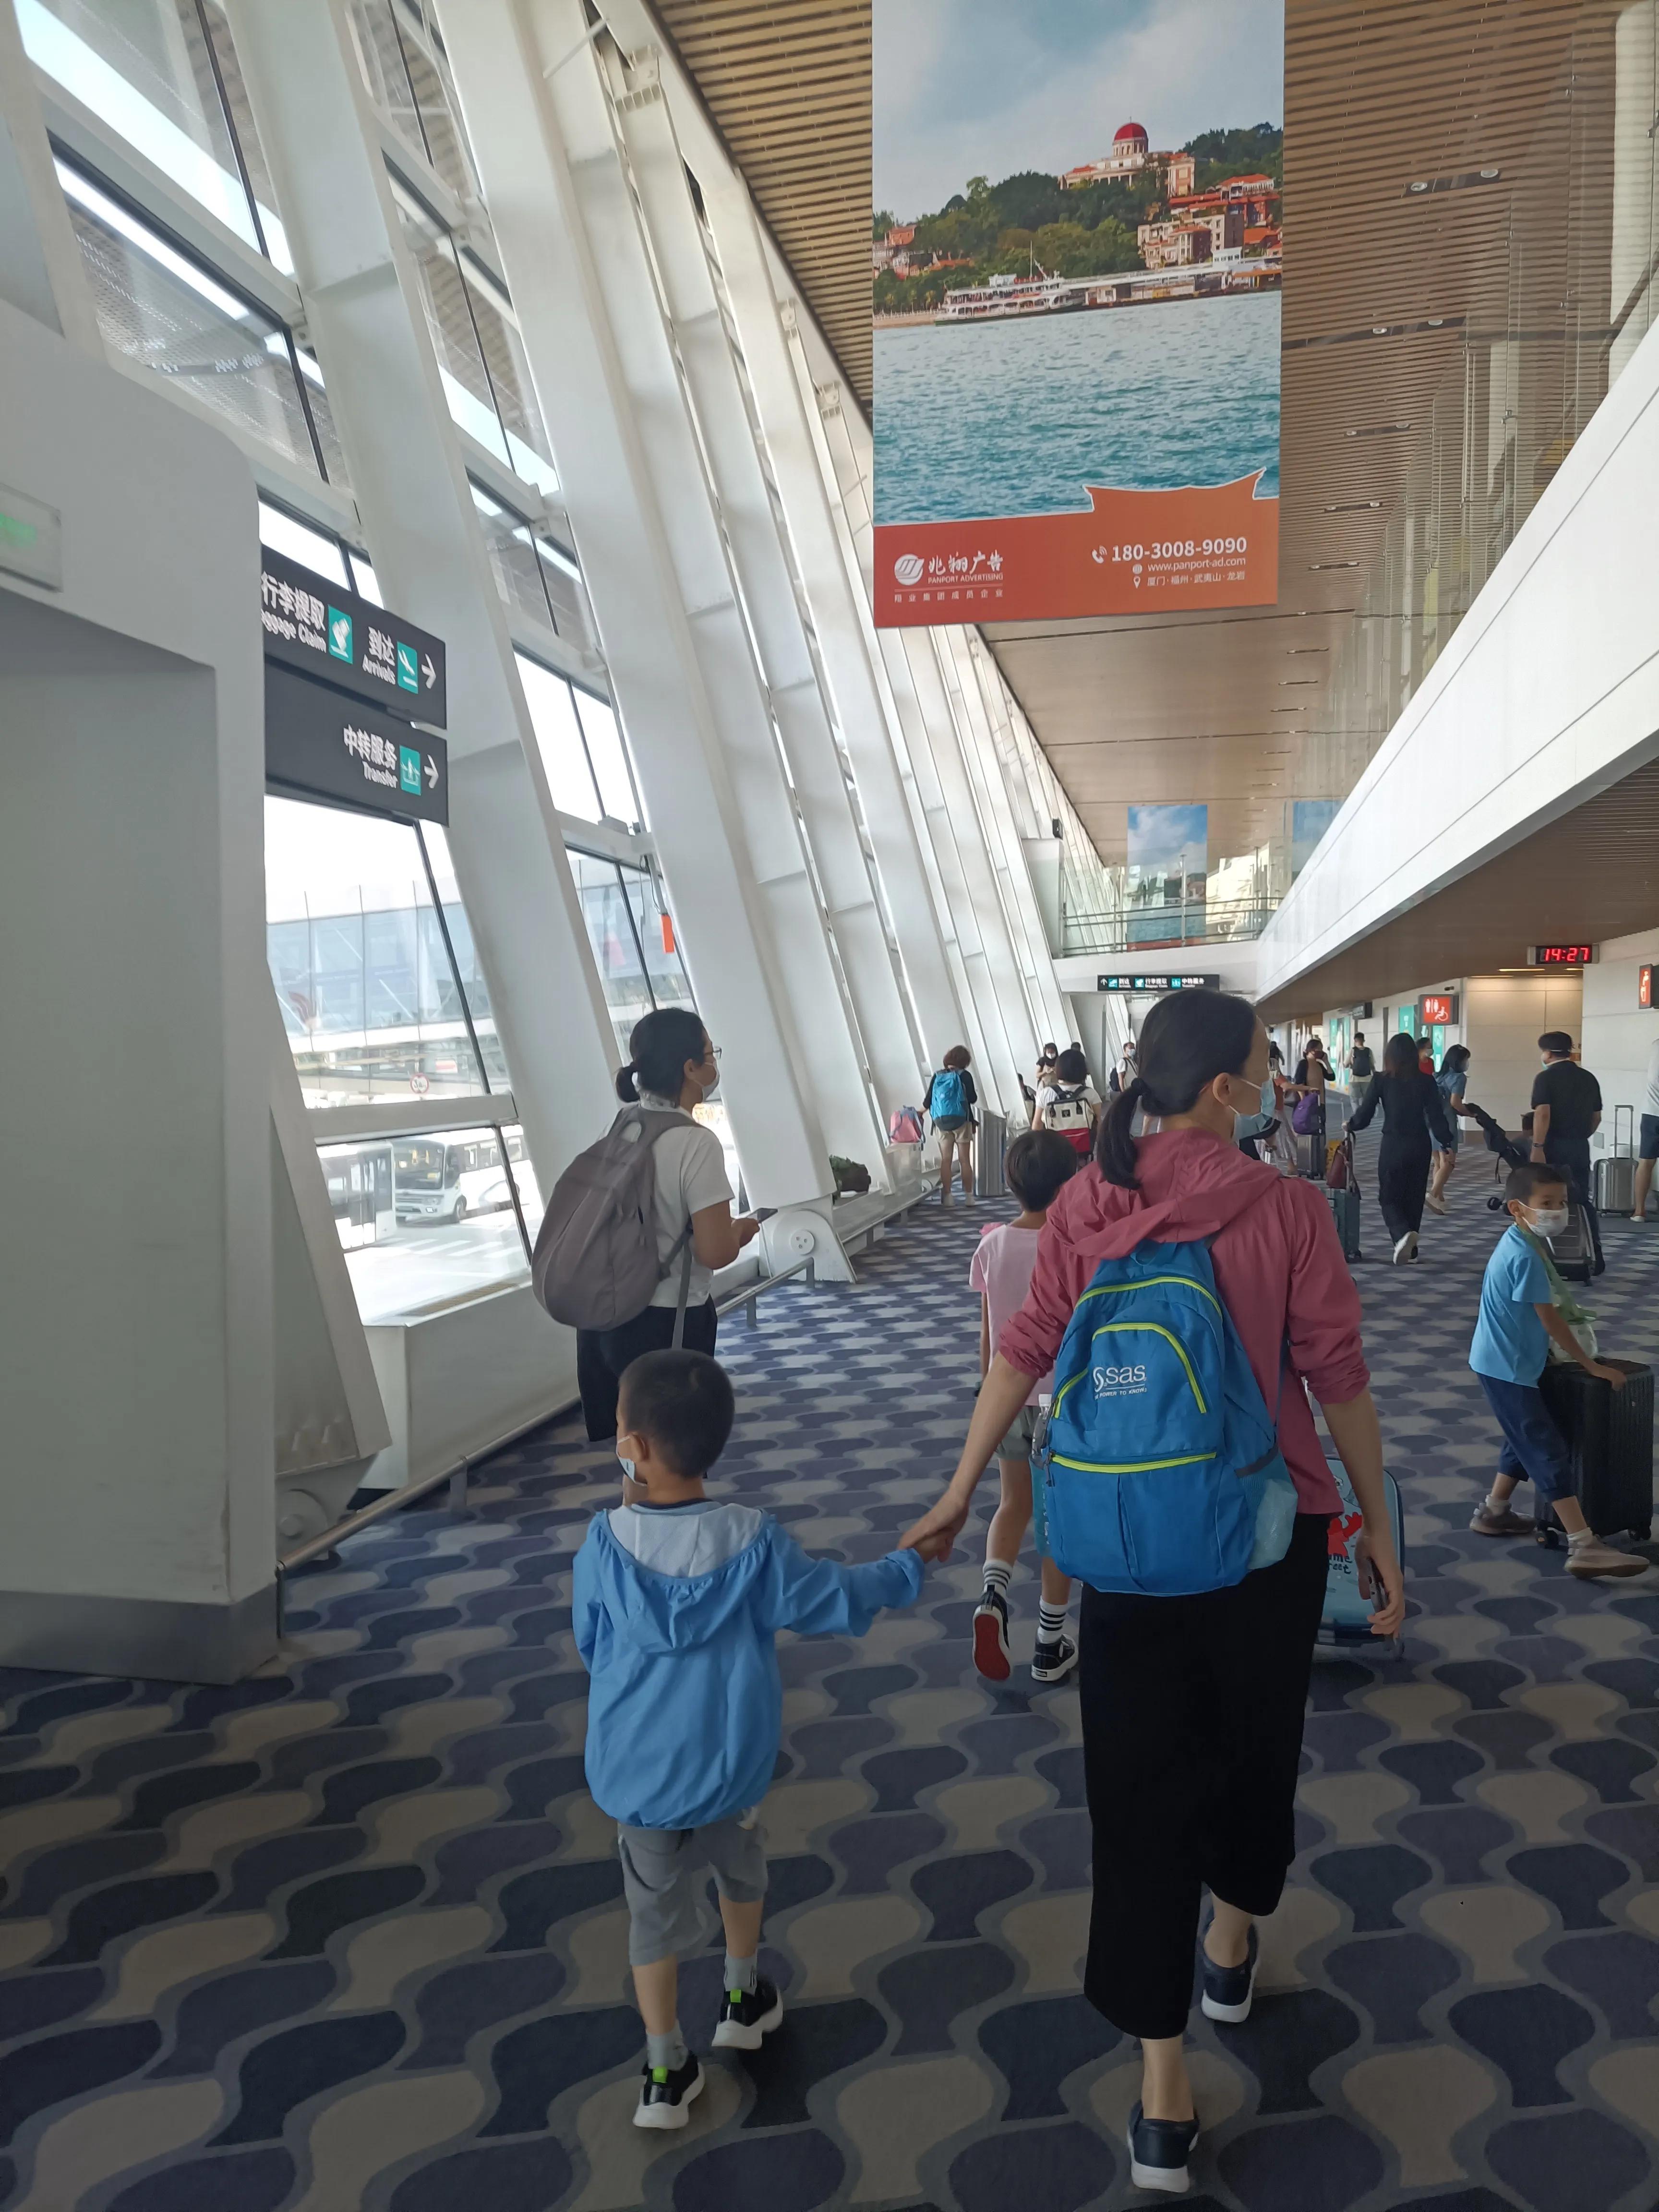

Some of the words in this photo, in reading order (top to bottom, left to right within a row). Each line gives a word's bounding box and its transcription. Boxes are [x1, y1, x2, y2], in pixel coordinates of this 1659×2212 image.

[1112, 537, 1247, 562] 180-3008-9090
[928, 576, 959, 584] PANPORT
[960, 572, 1003, 582] ADVERTISING
[1147, 557, 1246, 572] www.panport-ad.com
[261, 571, 326, 631] 行李提取
[298, 623, 326, 653] Claim
[368, 626, 396, 667] 到达
[362, 654, 396, 685] Arrivals
[343, 724, 397, 770] 中转服务
[362, 760, 398, 788] Transfer
[1545, 948, 1589, 962] 14:27
[1106, 1365, 1146, 1384] sas
